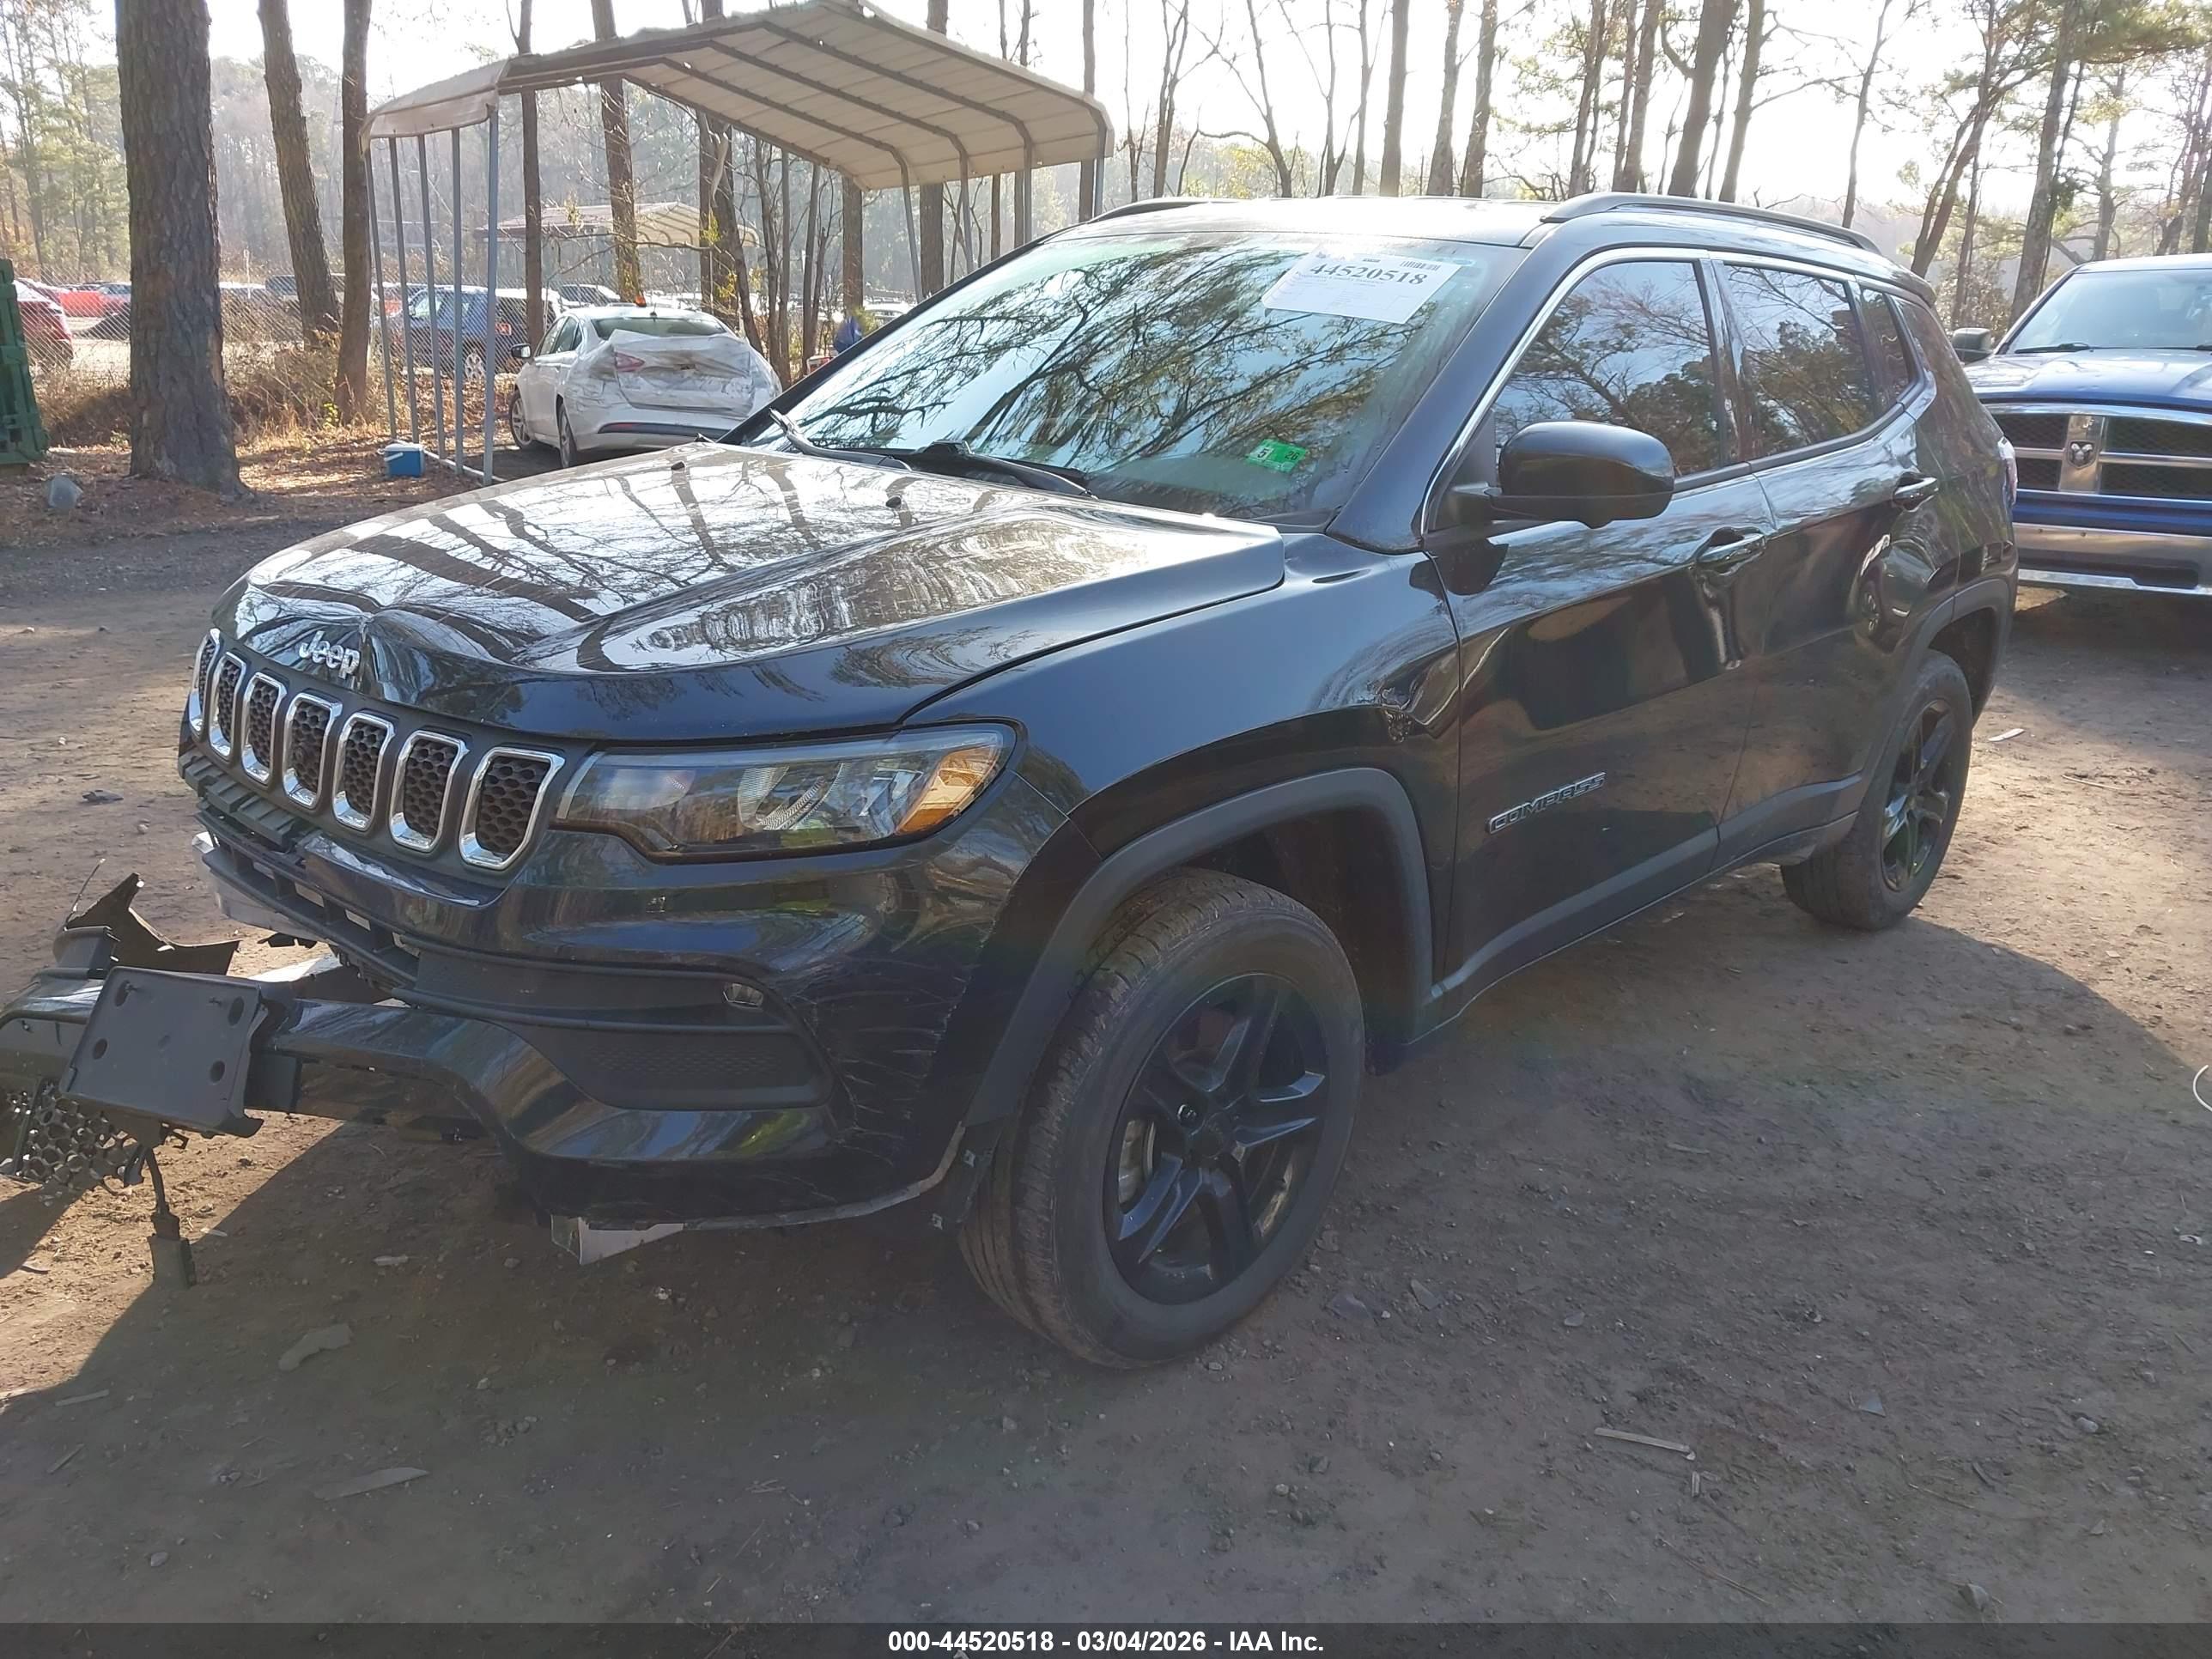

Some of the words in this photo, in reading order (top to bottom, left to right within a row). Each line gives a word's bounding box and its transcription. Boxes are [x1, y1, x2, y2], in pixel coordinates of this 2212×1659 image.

[1310, 263, 1428, 285] 44520518
[1256, 447, 1270, 459] 5
[298, 630, 361, 680] Jeep
[1487, 771, 1607, 835] COMPASS
